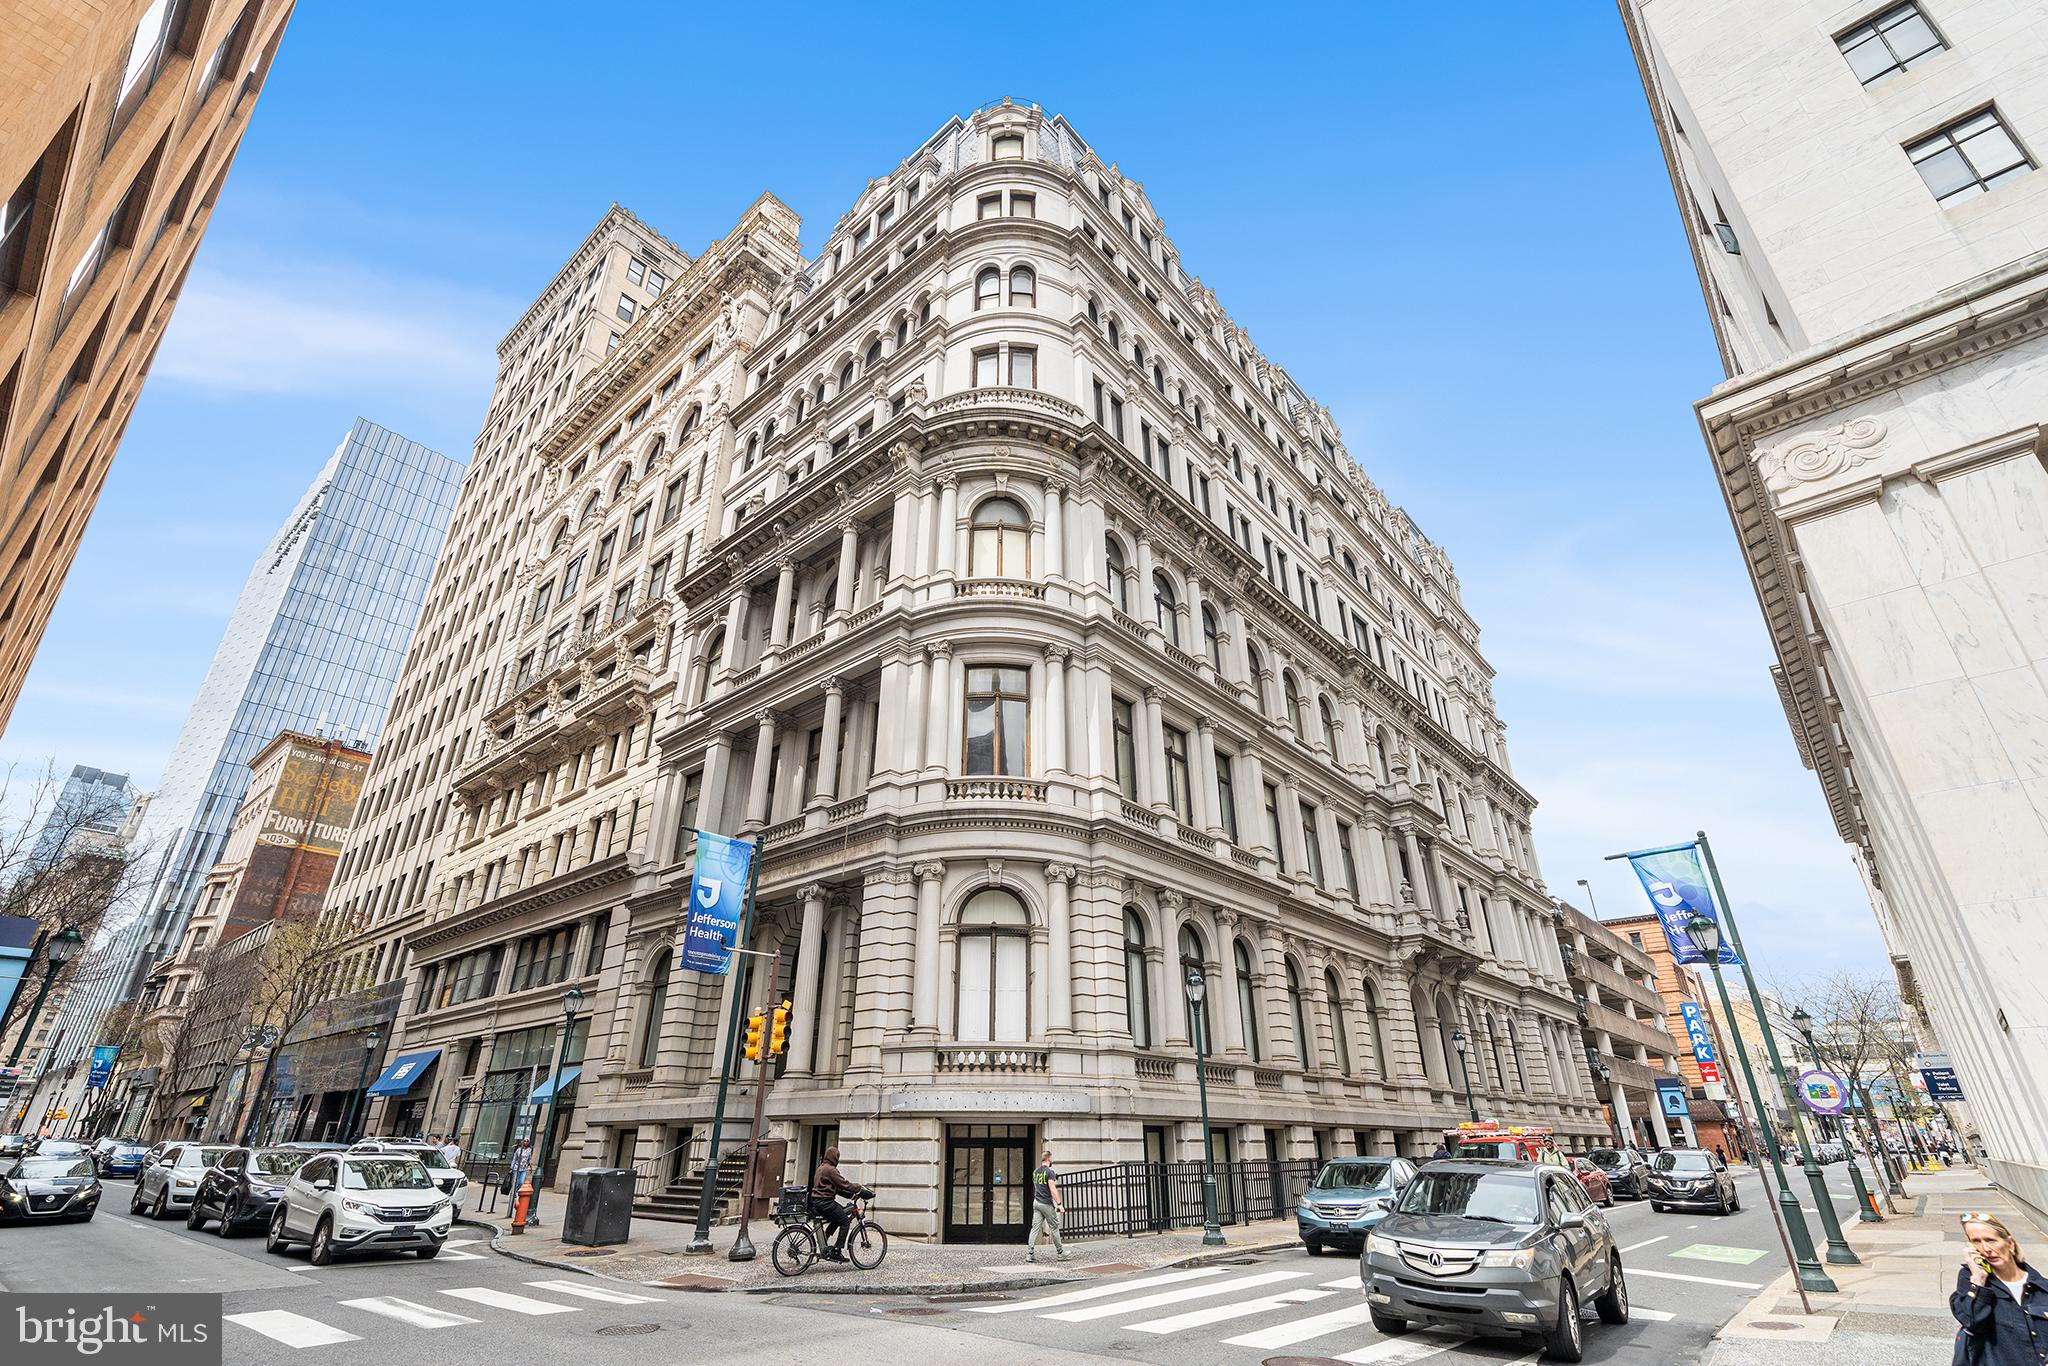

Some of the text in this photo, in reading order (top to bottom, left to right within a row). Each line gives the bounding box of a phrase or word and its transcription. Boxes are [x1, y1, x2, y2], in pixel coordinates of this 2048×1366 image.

[291, 750, 364, 773] YOU SAVE MORE AT
[282, 760, 361, 801] Society
[278, 786, 332, 817] Hill
[689, 926, 723, 941] Health
[691, 912, 736, 930] Jefferson
[1685, 1006, 1711, 1059] PARK
